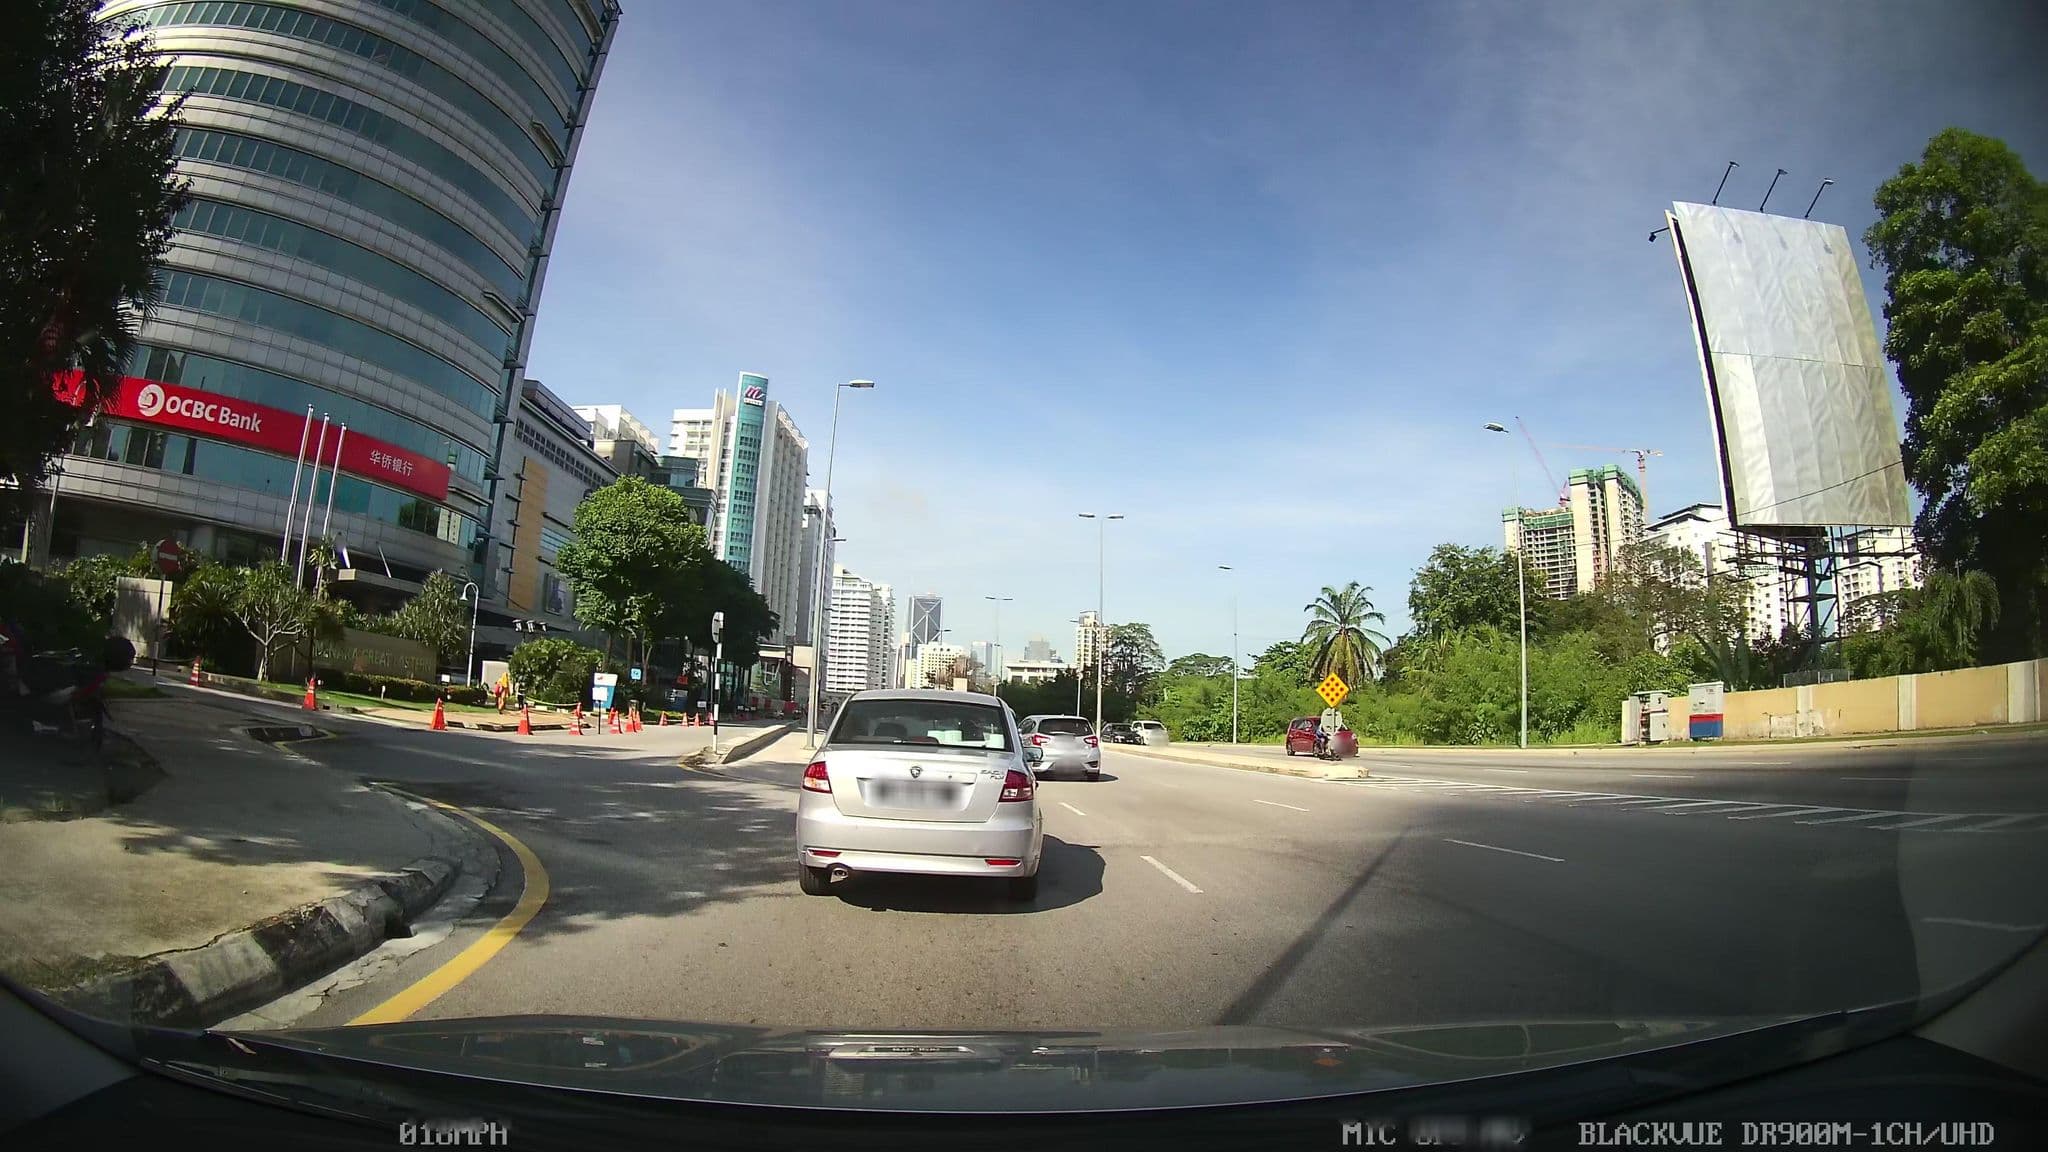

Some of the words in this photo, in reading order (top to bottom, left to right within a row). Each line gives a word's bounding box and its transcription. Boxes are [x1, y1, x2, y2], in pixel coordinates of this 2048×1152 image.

[165, 395, 218, 422] OCBC
[218, 406, 263, 433] Bank
[369, 449, 413, 477] 华侨银行
